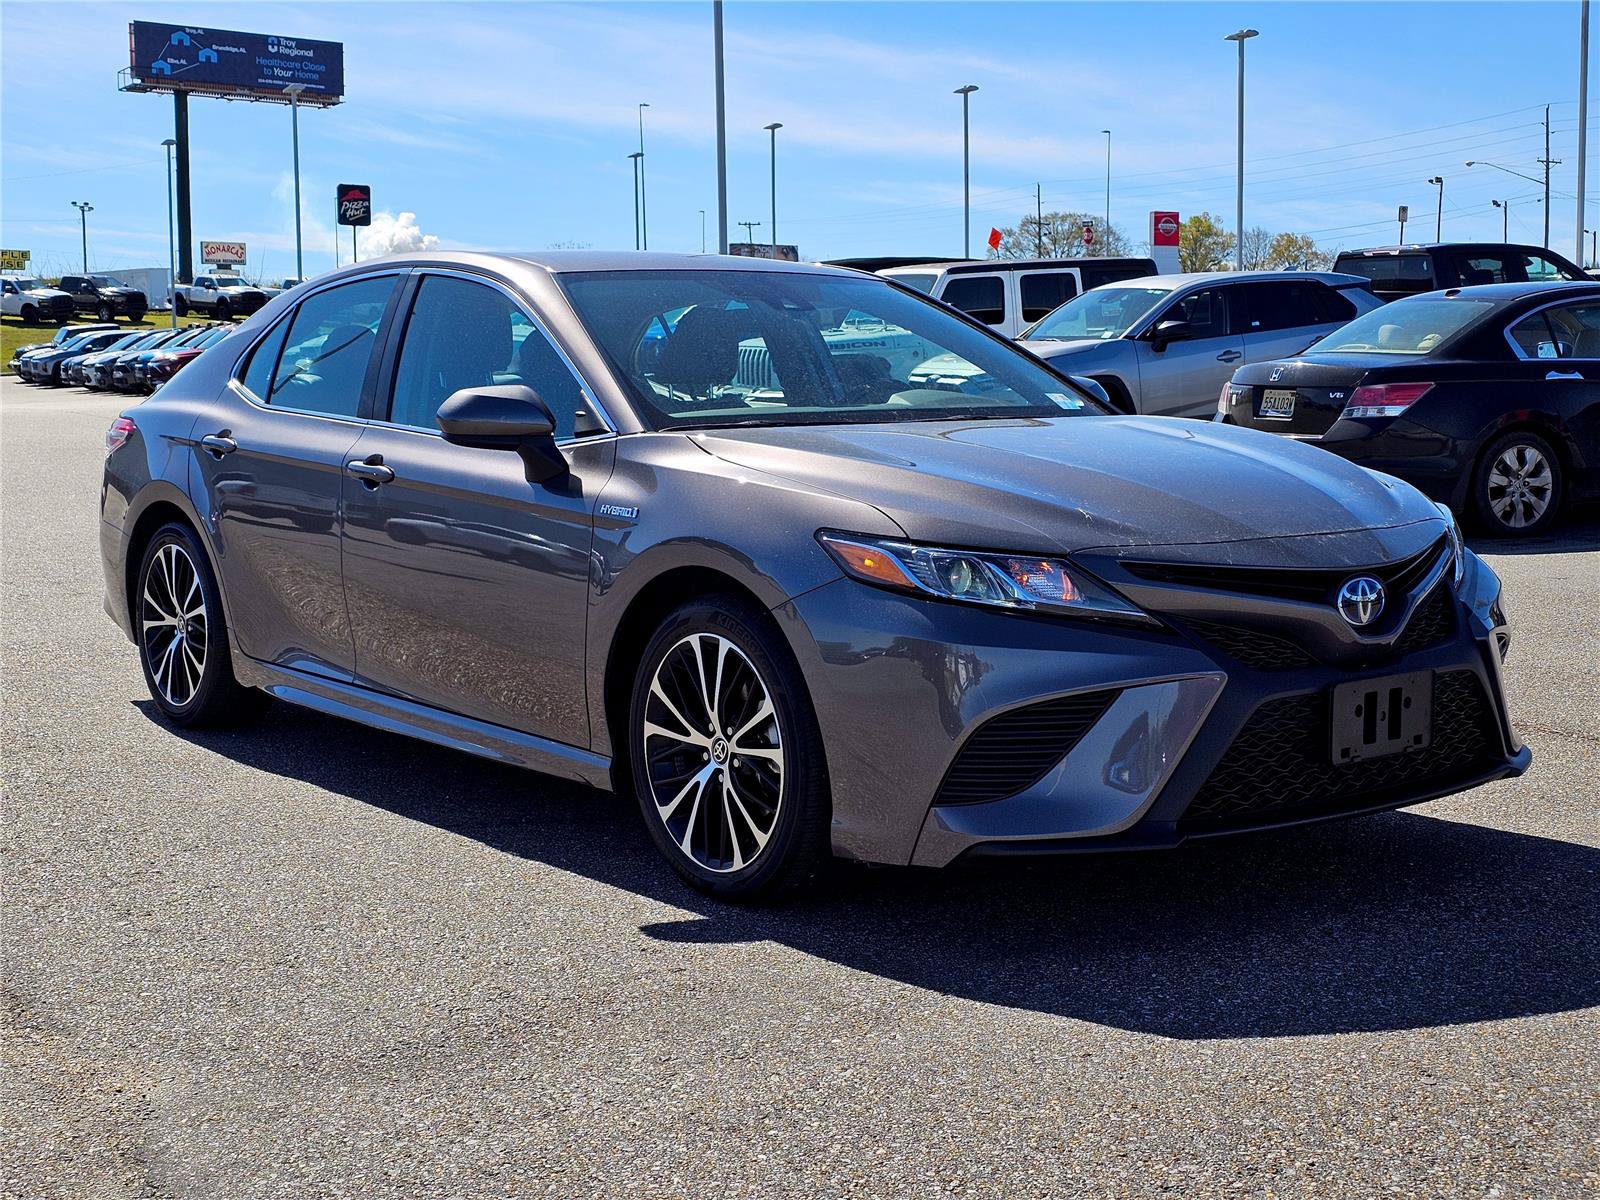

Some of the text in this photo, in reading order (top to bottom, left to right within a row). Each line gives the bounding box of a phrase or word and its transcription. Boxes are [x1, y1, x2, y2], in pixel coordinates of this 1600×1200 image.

[279, 37, 296, 48] Troy
[279, 46, 314, 57] Regional
[255, 56, 326, 72] Healthcare Close
[263, 66, 319, 80] to Your Home
[341, 201, 369, 215] Pizza
[346, 208, 366, 218] Hut
[205, 244, 244, 259] MONARCAS
[600, 504, 632, 518] HYBRID
